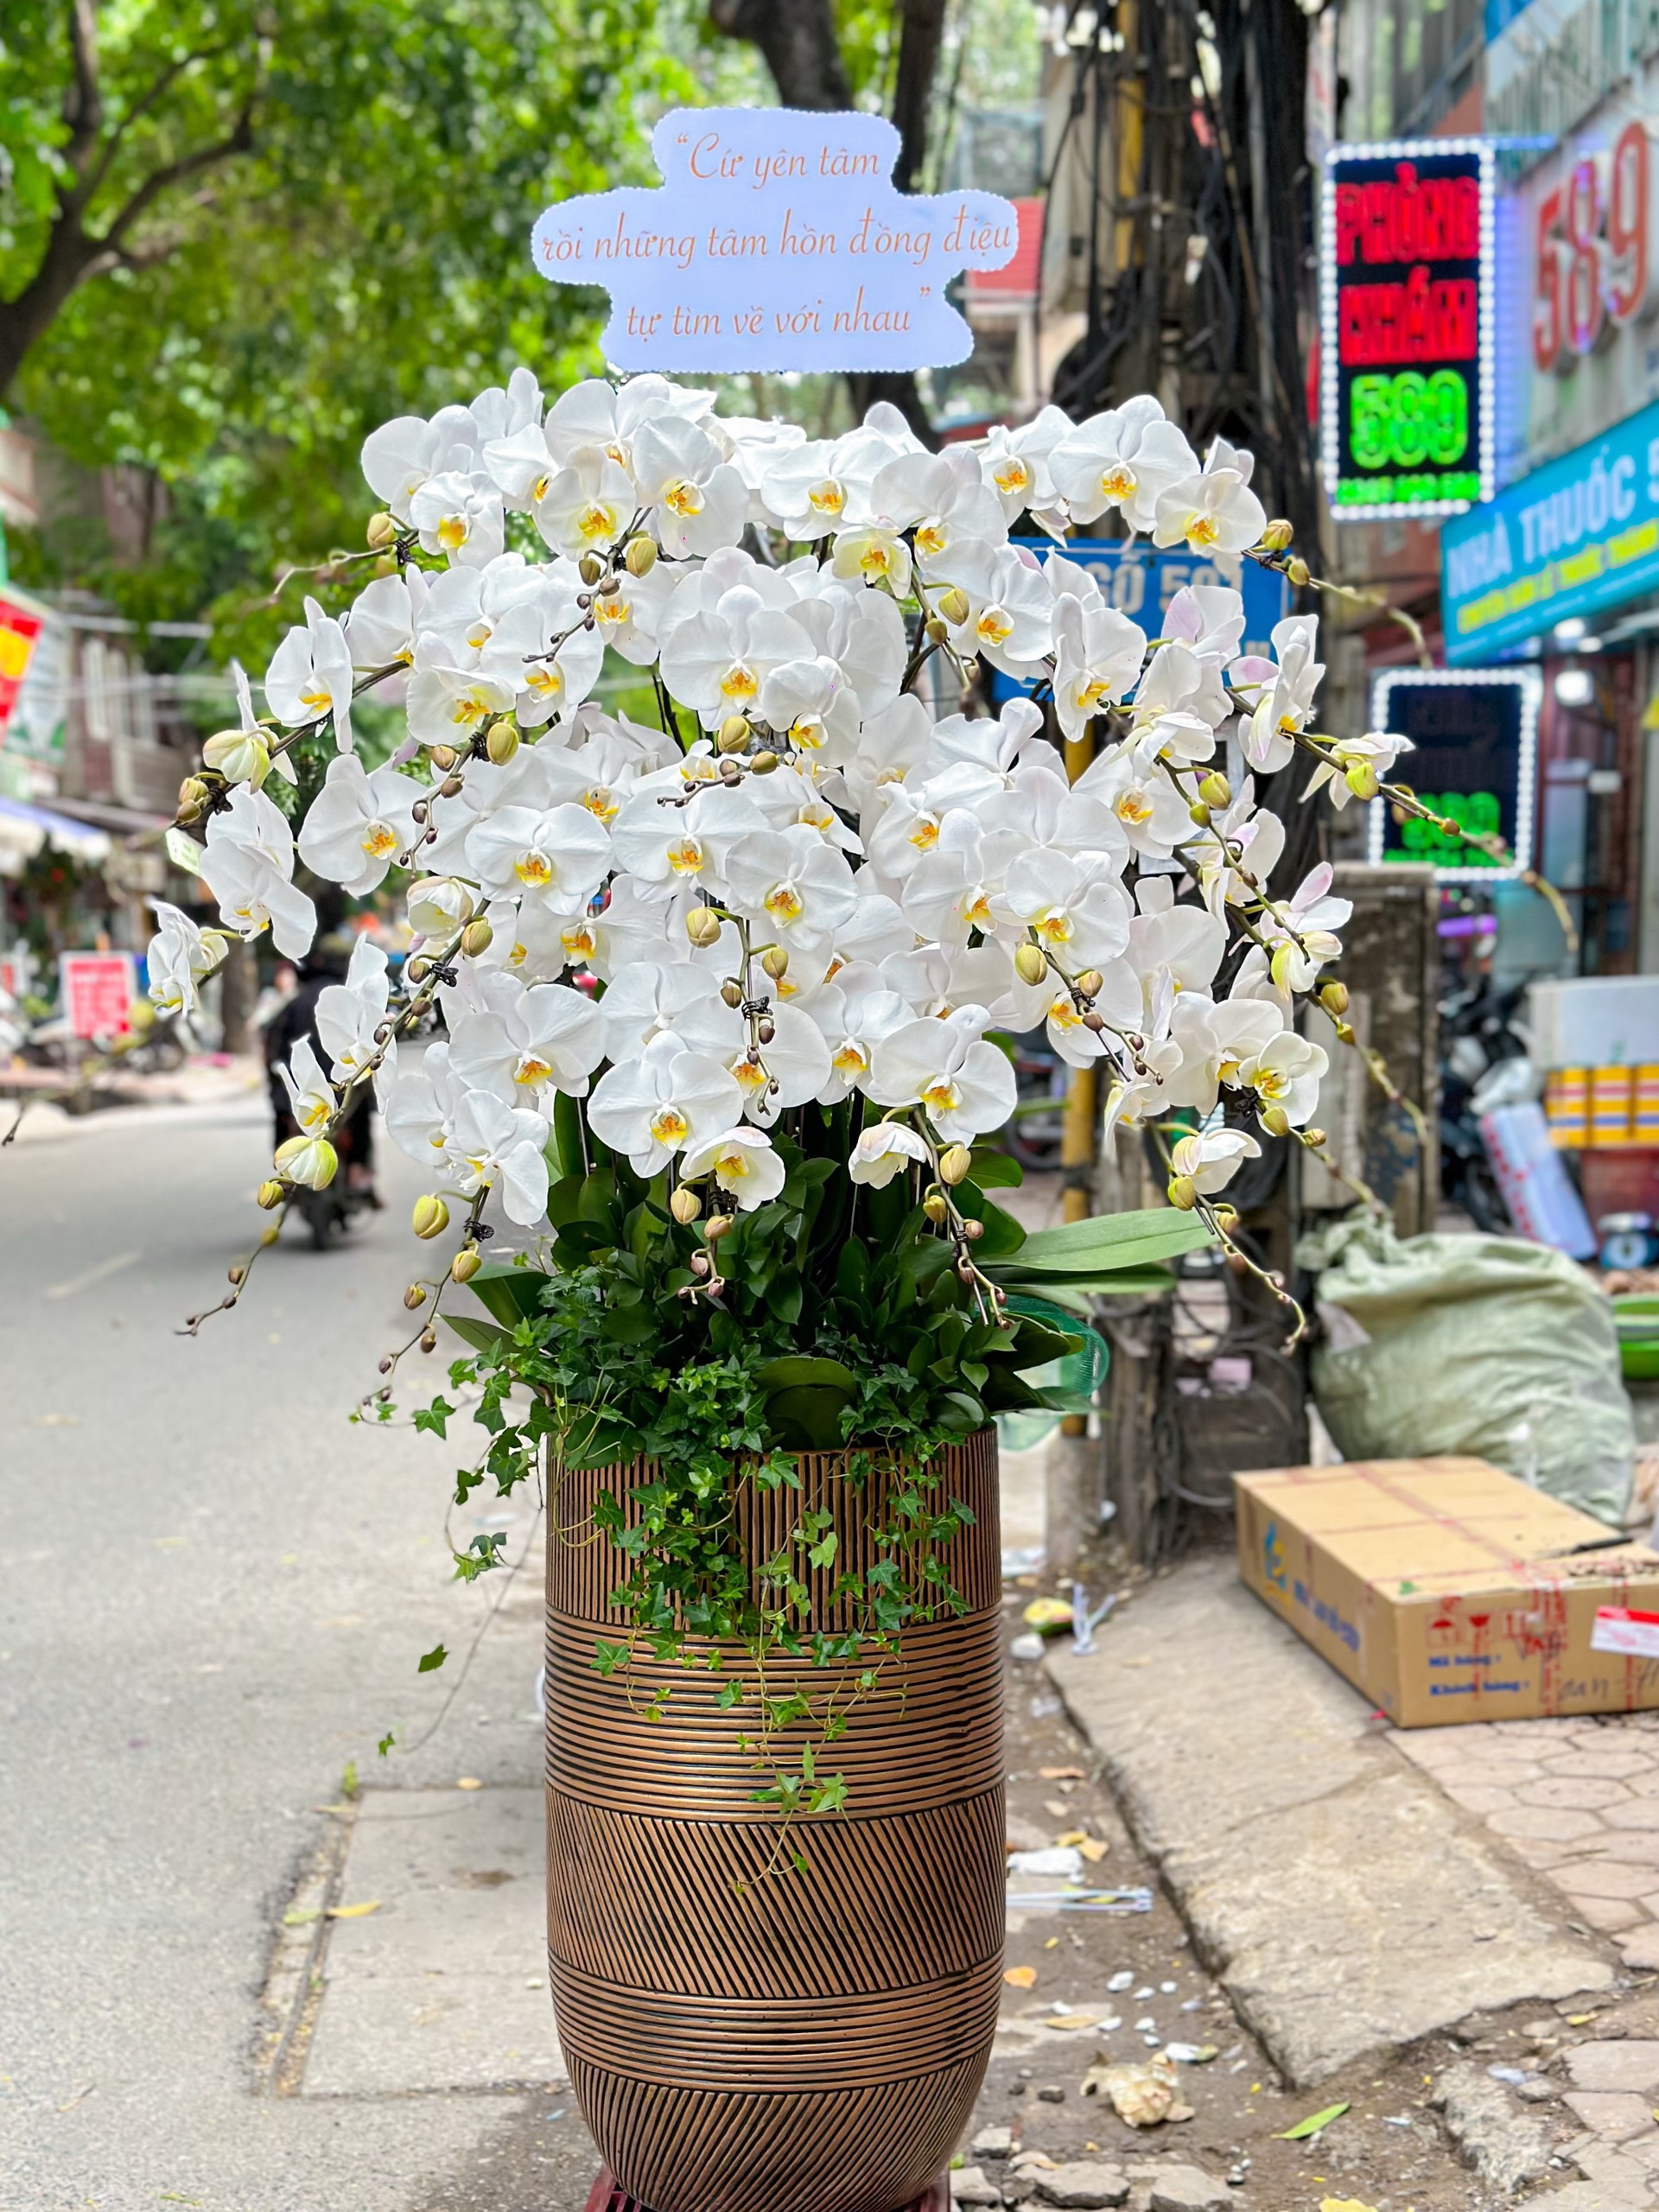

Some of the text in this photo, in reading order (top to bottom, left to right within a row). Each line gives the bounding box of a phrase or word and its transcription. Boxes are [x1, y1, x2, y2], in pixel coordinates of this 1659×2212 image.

[753, 149, 808, 190] yên
[819, 146, 880, 176] tâm
[542, 203, 1012, 270] rồi những tâm hồn đồng điệu
[1532, 120, 1652, 373] 589
[626, 305, 663, 343] tự
[672, 304, 722, 336] tìm
[733, 305, 766, 336] về
[775, 300, 823, 335] với
[1339, 265, 1478, 366] KHÁM
[1350, 369, 1468, 470] 589
[1446, 512, 1513, 600] NHÀ
[1518, 444, 1637, 565] THUỐC
[1084, 551, 1147, 616] GÕ
